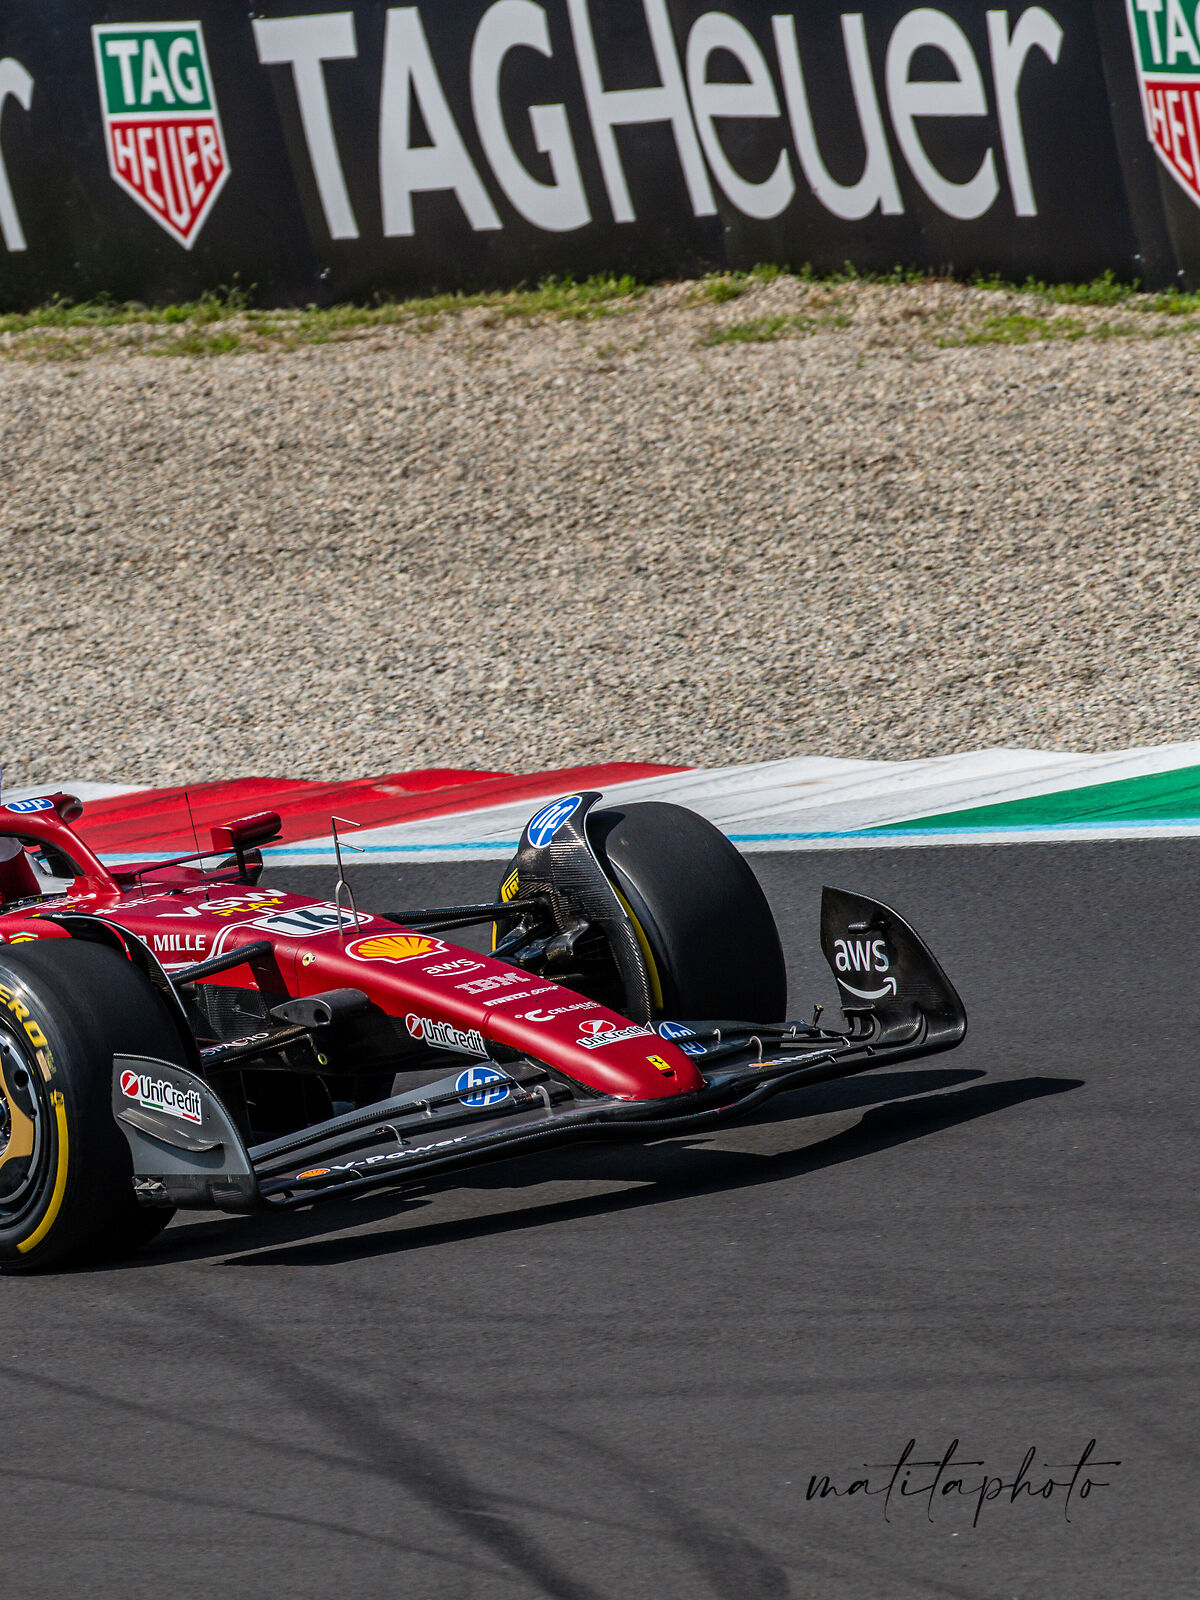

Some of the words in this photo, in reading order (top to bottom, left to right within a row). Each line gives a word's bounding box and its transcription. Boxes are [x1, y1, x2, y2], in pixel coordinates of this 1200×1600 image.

[1136, 0, 1200, 66] TA
[105, 37, 203, 105] TAG
[110, 124, 221, 232] HEUER
[14, 798, 50, 811] hp
[156, 889, 288, 918] VGW
[212, 898, 284, 917] PLAY
[267, 909, 352, 931] 16
[153, 934, 207, 952] MILLE
[834, 939, 889, 973] aws
[422, 958, 476, 975] aws
[454, 972, 531, 995] IBM
[422, 1018, 484, 1052] UniCredit
[578, 1026, 647, 1046] UniCredit
[139, 1076, 201, 1116] UniCredit
[331, 1135, 467, 1170] V-Power
